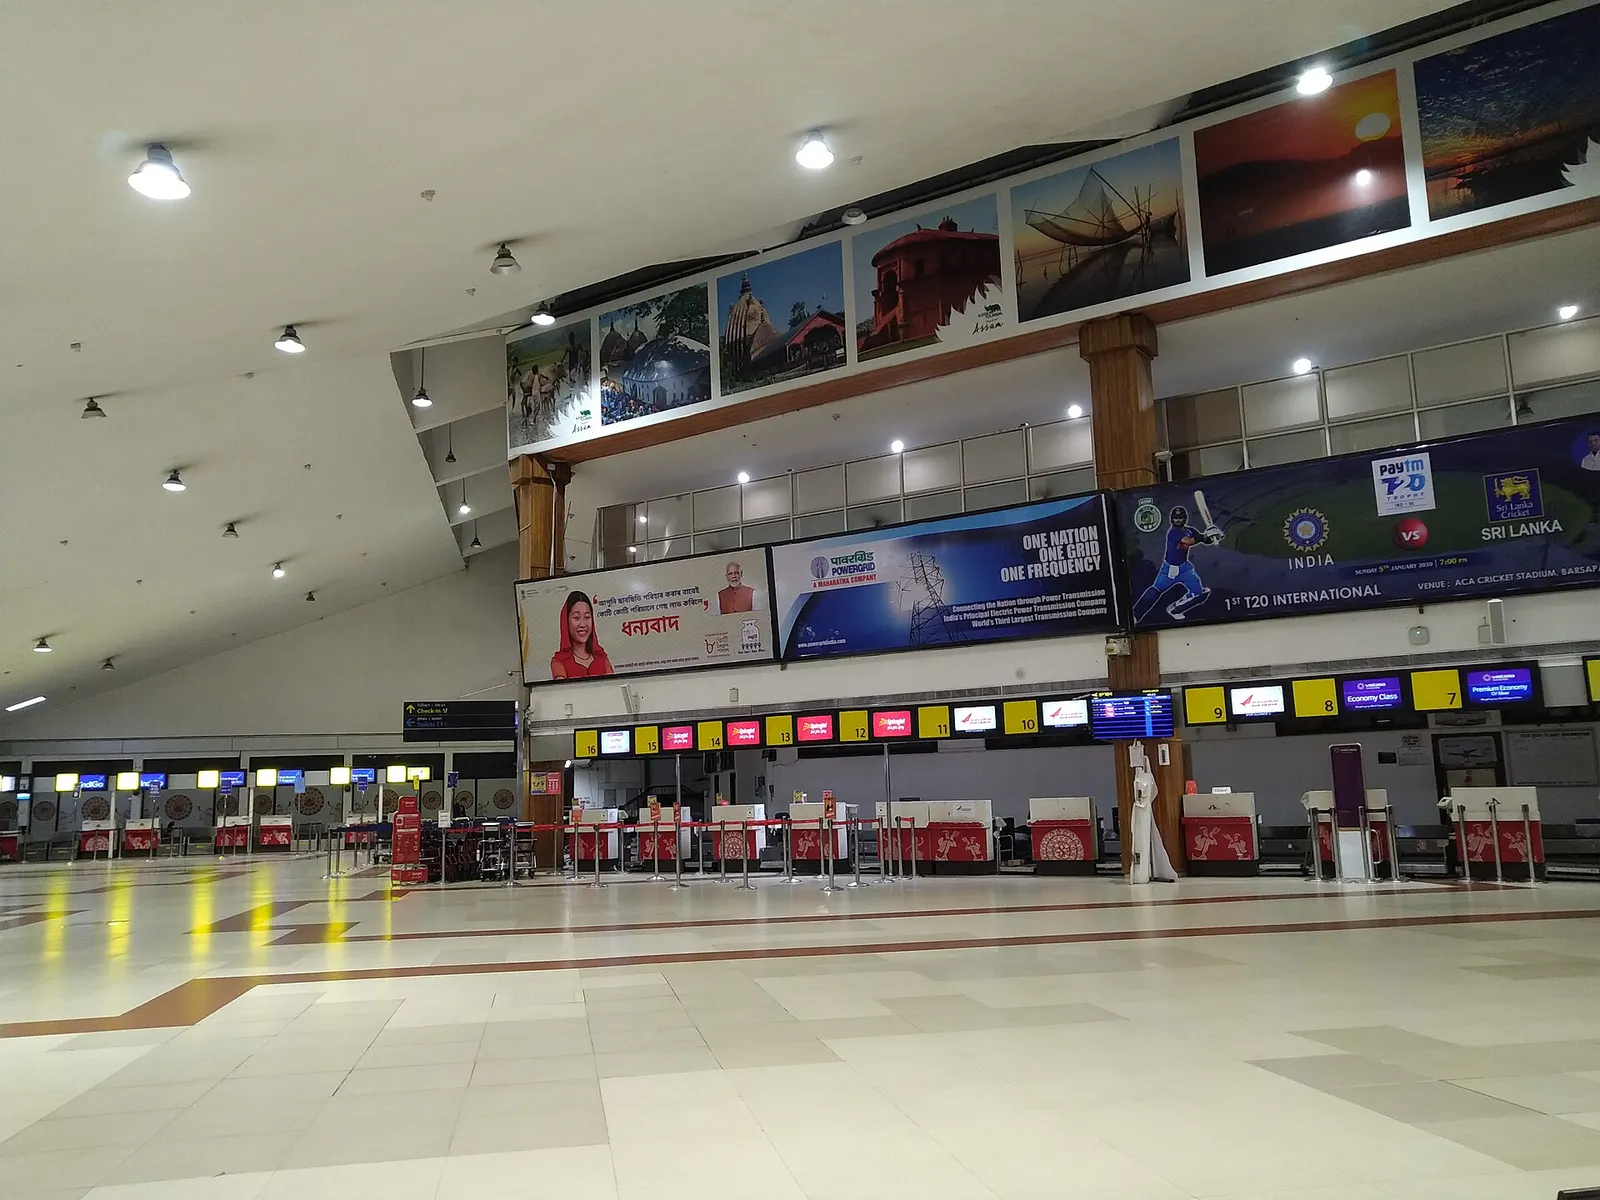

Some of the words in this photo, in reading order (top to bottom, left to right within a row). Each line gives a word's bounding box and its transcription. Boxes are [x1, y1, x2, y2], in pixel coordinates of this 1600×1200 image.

[972, 322, 1004, 335] Assam
[1387, 492, 1424, 501] TROPHY
[1496, 504, 1507, 512] Sri
[1510, 501, 1533, 510] Lanka
[1501, 510, 1530, 518] Cricket
[1482, 526, 1506, 540] SRI
[1510, 519, 1563, 537] LANKA
[1023, 533, 1048, 550] ONE
[1050, 525, 1098, 546] NATION
[830, 551, 874, 565] पावरग्रिड
[1039, 546, 1064, 562] ONE
[1067, 541, 1100, 559] GRID
[1288, 553, 1334, 570] INDIA
[832, 562, 875, 576] POWERGRID
[1000, 565, 1025, 582] ONE
[1027, 555, 1101, 579] FREQUENCY
[818, 578, 849, 588] MAHARATNA
[851, 574, 876, 583] COMPANY
[1418, 580, 1445, 590] VENUE
[1455, 578, 1475, 586] ACA
[1477, 573, 1514, 584] CRICKET
[1561, 565, 1600, 576] BARSAP
[952, 603, 985, 612] Connecting
[997, 599, 1016, 607] Nation
[1017, 596, 1041, 605] through
[1042, 594, 1061, 602] Power
[1062, 589, 1105, 600] Transmission
[1244, 595, 1268, 608] T20
[1273, 584, 1381, 606] INTERNATIONAL
[944, 614, 963, 622] India's
[964, 611, 989, 620] Principal
[990, 608, 1013, 616] Electric
[1014, 606, 1032, 614] Power
[1033, 601, 1075, 612] Transmission
[1076, 598, 1106, 607] Company
[972, 619, 994, 627] World's
[995, 616, 1010, 625] Third
[1011, 615, 1033, 623] Largest
[1034, 610, 1076, 620] Transmission
[1078, 607, 1107, 616] Company
[621, 616, 680, 636] ধন্যবাদ
[1447, 693, 1456, 705] 7
[1325, 700, 1334, 712] 8
[1214, 708, 1222, 718] 9
[937, 724, 947, 734] 11
[1022, 720, 1035, 730] 10
[780, 732, 791, 742] 13
[855, 728, 866, 738] 12
[648, 742, 656, 750] 15
[710, 738, 720, 747] 14
[587, 746, 595, 754] 16
